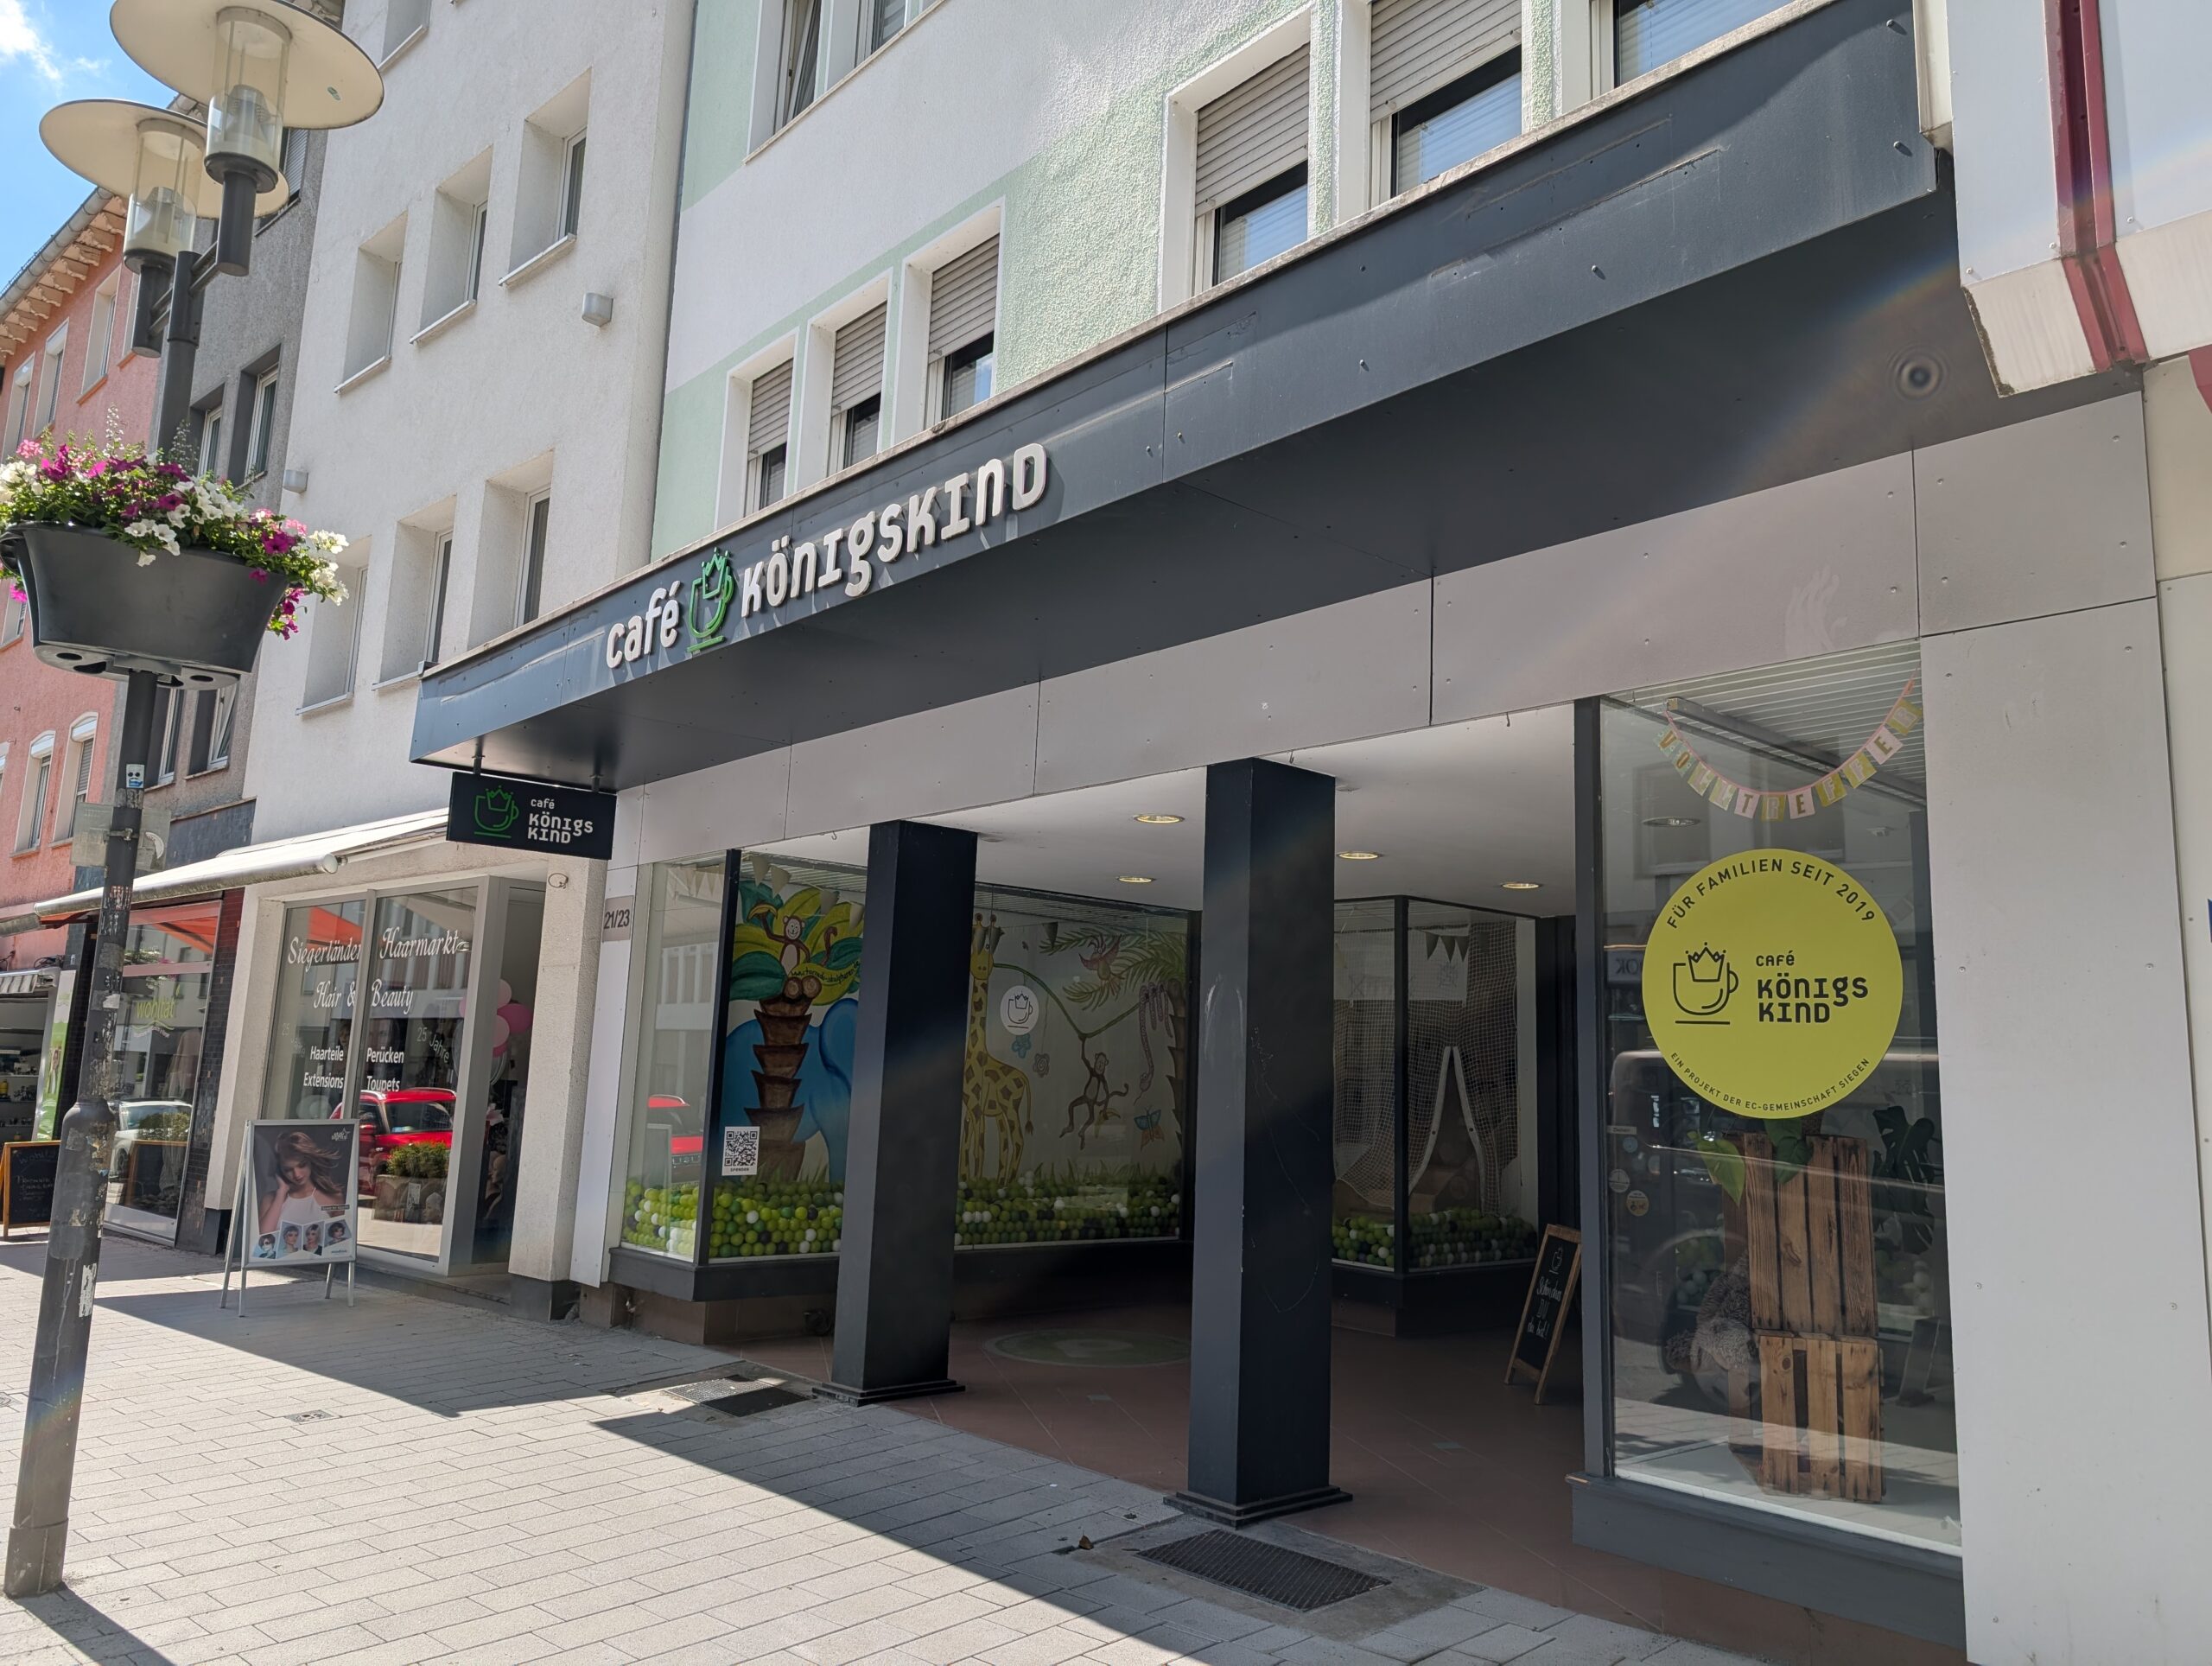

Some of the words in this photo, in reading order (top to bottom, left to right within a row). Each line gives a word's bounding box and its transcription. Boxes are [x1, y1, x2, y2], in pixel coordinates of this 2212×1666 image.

[606, 580, 681, 669] café
[531, 798, 555, 810] café
[1667, 896, 1695, 929] FÜR
[1696, 859, 1783, 896] FAMILIEN
[1790, 862, 1834, 886] SEIT
[1835, 883, 1875, 922] 2019
[603, 909, 630, 930] 21/23
[288, 936, 362, 973] Siegerländer
[379, 926, 459, 959] Haarmarkt
[314, 979, 342, 1009] Hair
[346, 981, 356, 1008] &
[372, 978, 414, 1014] Beauty
[309, 1046, 344, 1061] Haarteile
[366, 1046, 404, 1064] Perücken
[416, 1027, 427, 1042] 25
[429, 1033, 449, 1064] Jahre
[303, 1071, 344, 1089] Extensions
[366, 1075, 400, 1092] Toupets
[1670, 1052, 1685, 1069] EIN
[1684, 1067, 1721, 1097] PROJEKT
[1723, 1093, 1742, 1107] DER
[1745, 1085, 1838, 1112] EC-GEMEINSCHAFT
[1839, 1058, 1870, 1089] SIEGEN
